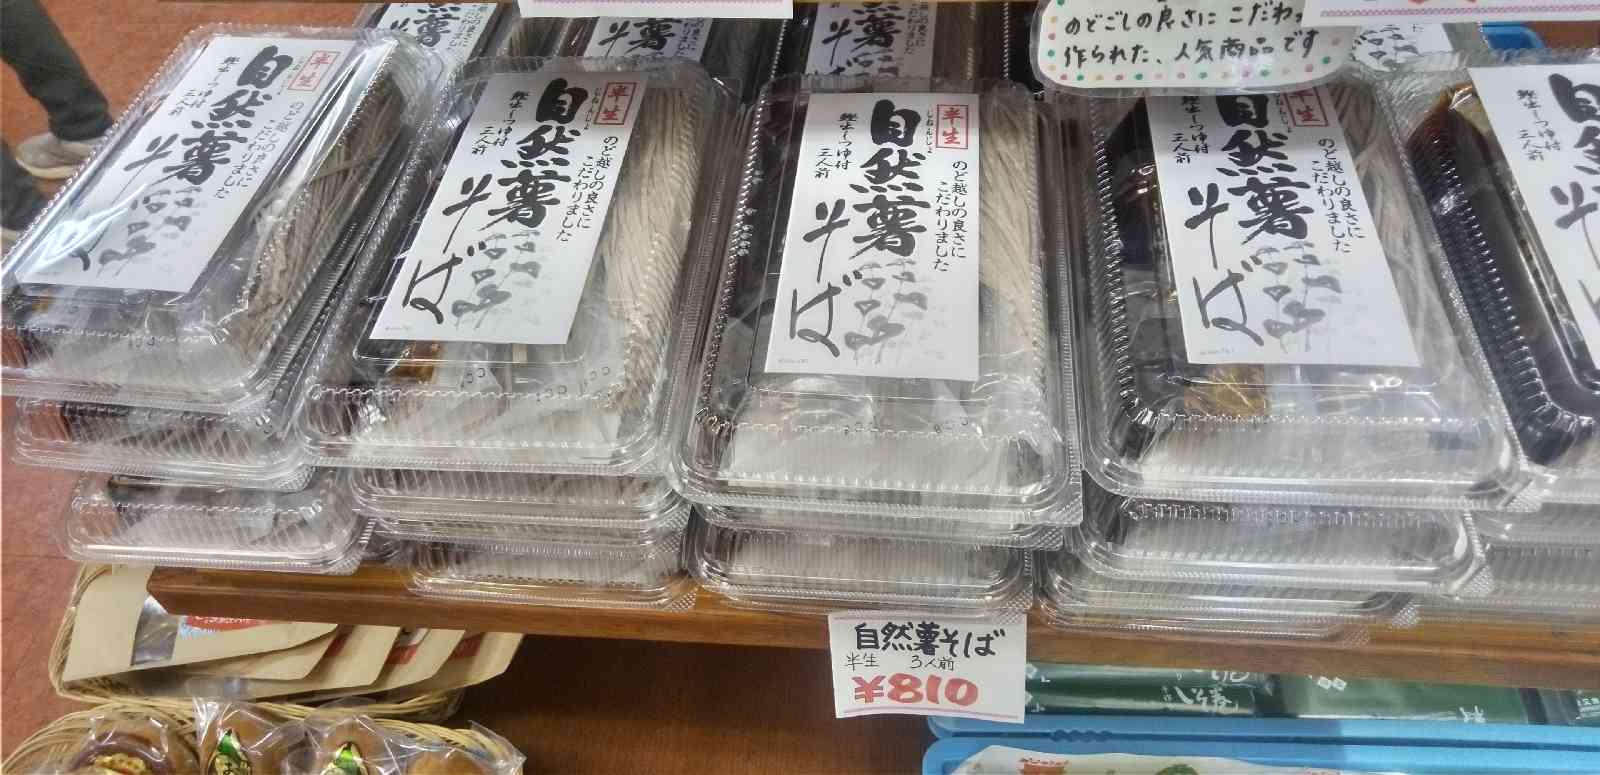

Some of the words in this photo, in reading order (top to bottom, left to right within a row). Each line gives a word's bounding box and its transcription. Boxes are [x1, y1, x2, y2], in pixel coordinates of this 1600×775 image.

[477, 78, 588, 228] 自然薯
[814, 147, 833, 179] 三人前
[941, 105, 965, 147] 半生
[1216, 95, 1315, 245] 自然薯
[556, 155, 594, 242] こだわりました
[576, 136, 618, 229] のど越しの良さに
[849, 99, 931, 257] 自然薯
[951, 159, 969, 258] のど越しの良さに
[1311, 160, 1352, 253] こだわりました
[1317, 138, 1365, 239] のど越しの良さに
[402, 173, 494, 324] そば
[934, 181, 951, 272] こだわりました
[1184, 182, 1264, 346] そば
[789, 198, 863, 358] そば
[845, 653, 880, 671] 半生
[910, 655, 954, 671] 3人前
[854, 621, 1006, 658] 自然薯そば
[851, 672, 979, 706] ¥810
